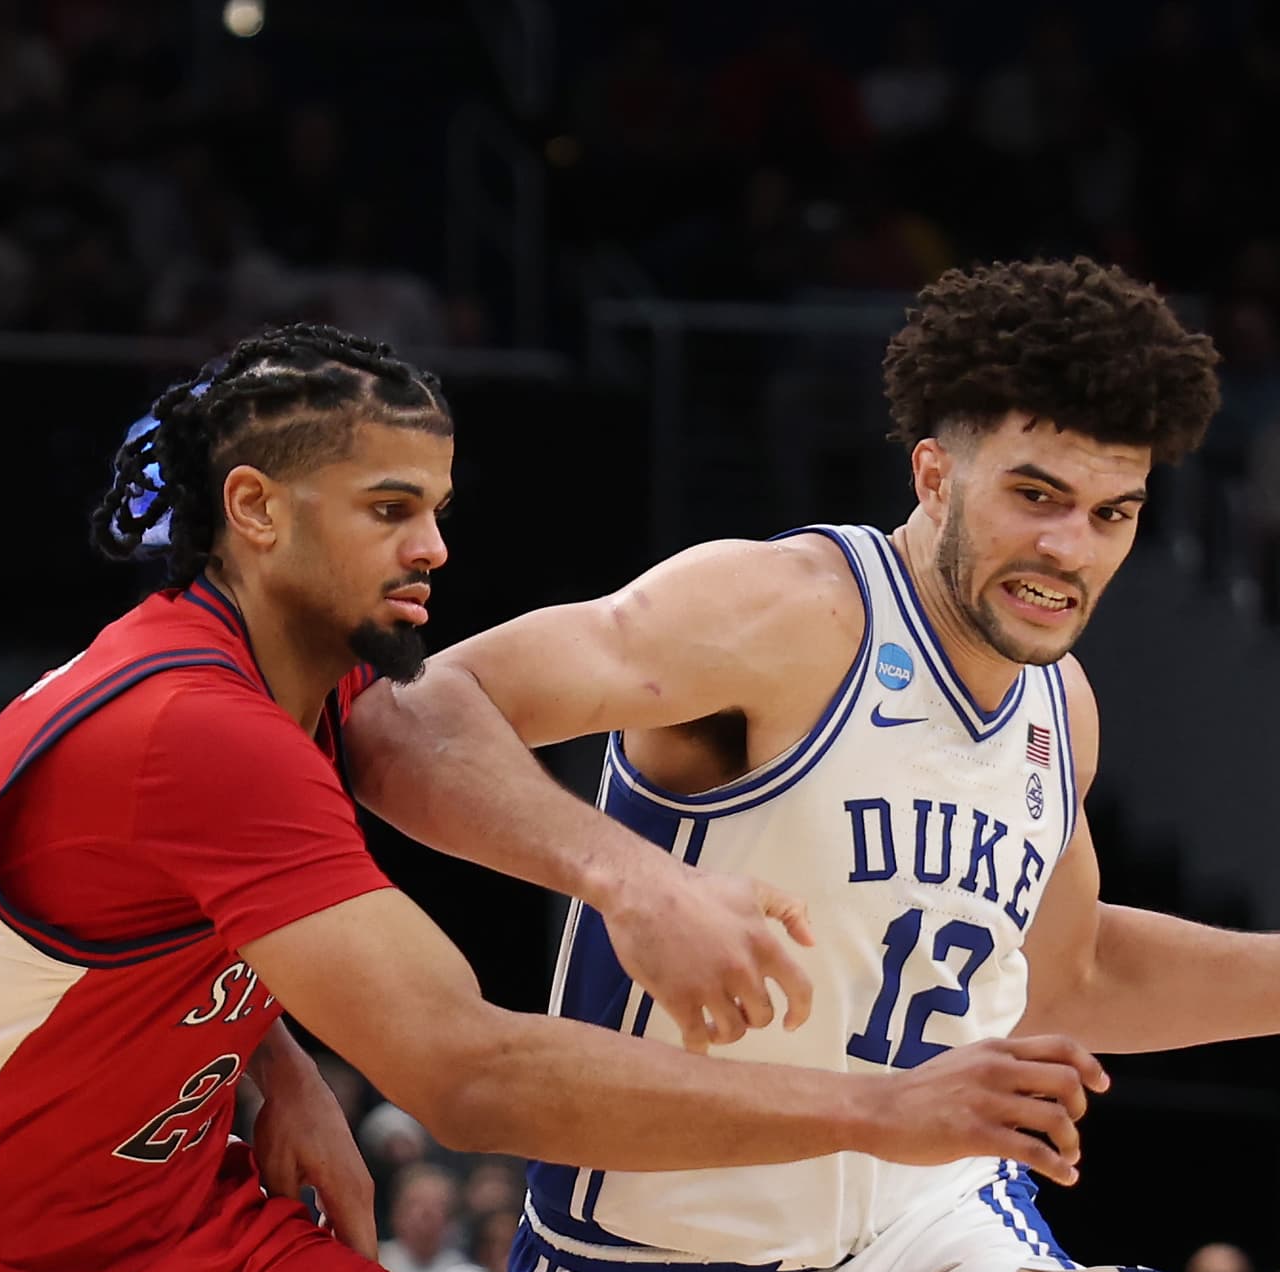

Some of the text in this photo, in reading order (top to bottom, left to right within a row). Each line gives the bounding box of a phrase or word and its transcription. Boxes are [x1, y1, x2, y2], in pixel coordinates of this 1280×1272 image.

[879, 661, 910, 682] NCAA
[844, 797, 1044, 931] DUKE
[846, 908, 995, 1069] 12
[111, 1053, 242, 1163] 2
